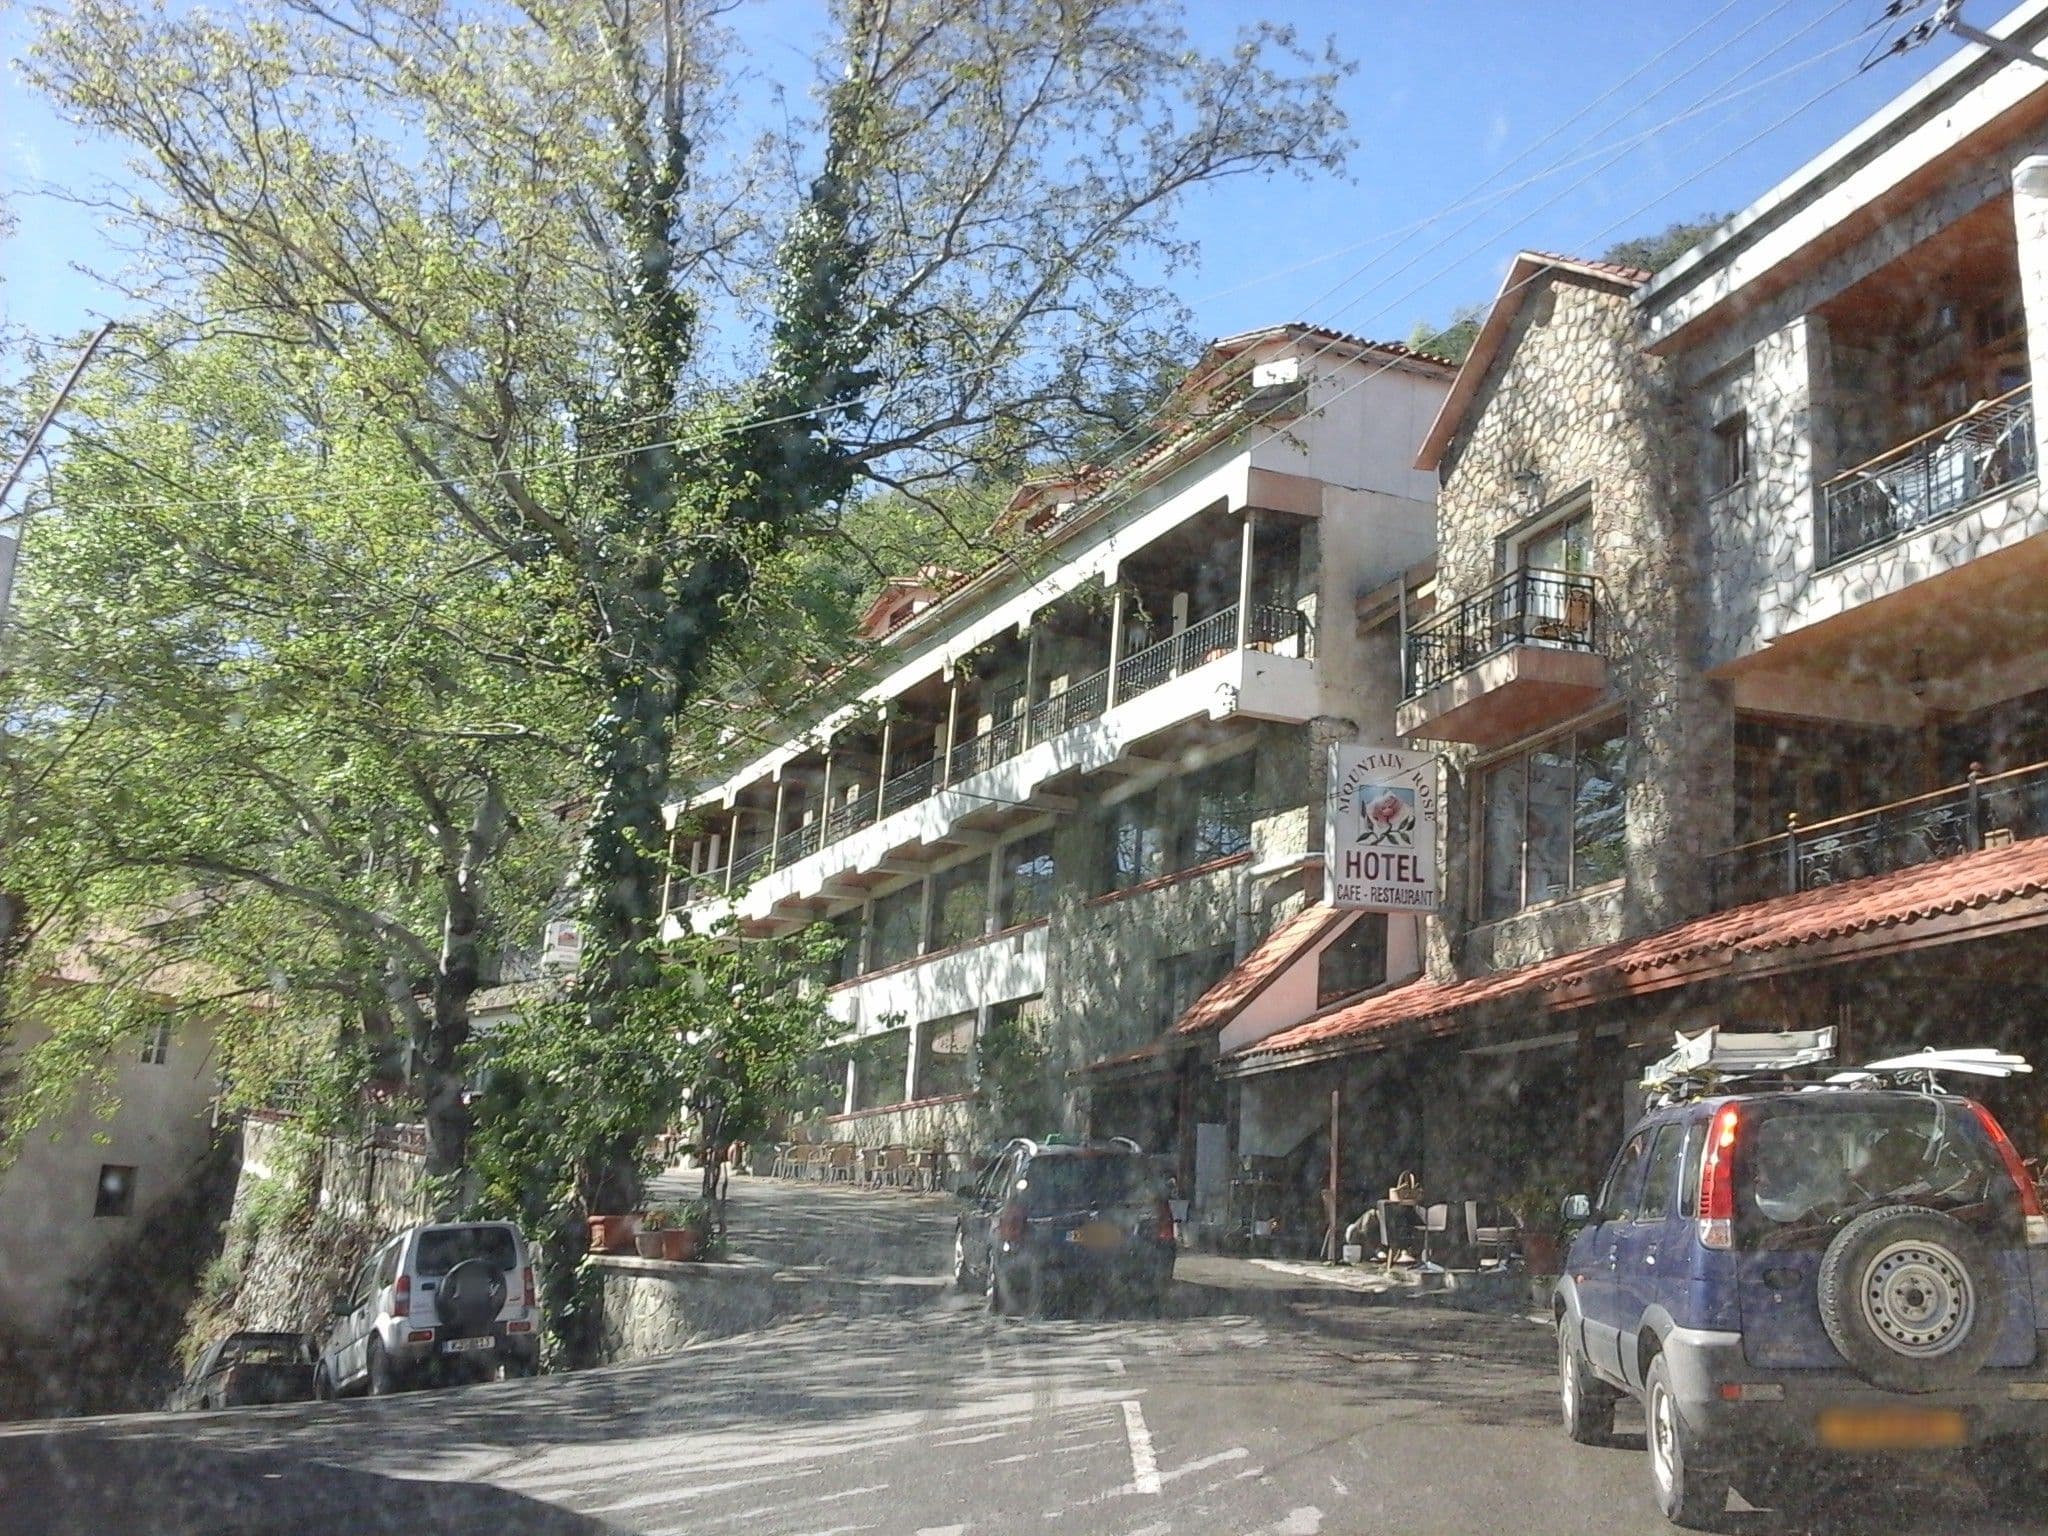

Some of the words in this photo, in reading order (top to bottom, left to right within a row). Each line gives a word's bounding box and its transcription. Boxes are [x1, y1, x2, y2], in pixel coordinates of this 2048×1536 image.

[1339, 753, 1404, 814] MOUNTAIN
[1411, 772, 1435, 822] ROSE
[1346, 850, 1424, 883] HOTEL
[1337, 884, 1361, 900] CAFE
[1370, 886, 1434, 906] RESTAURANT
